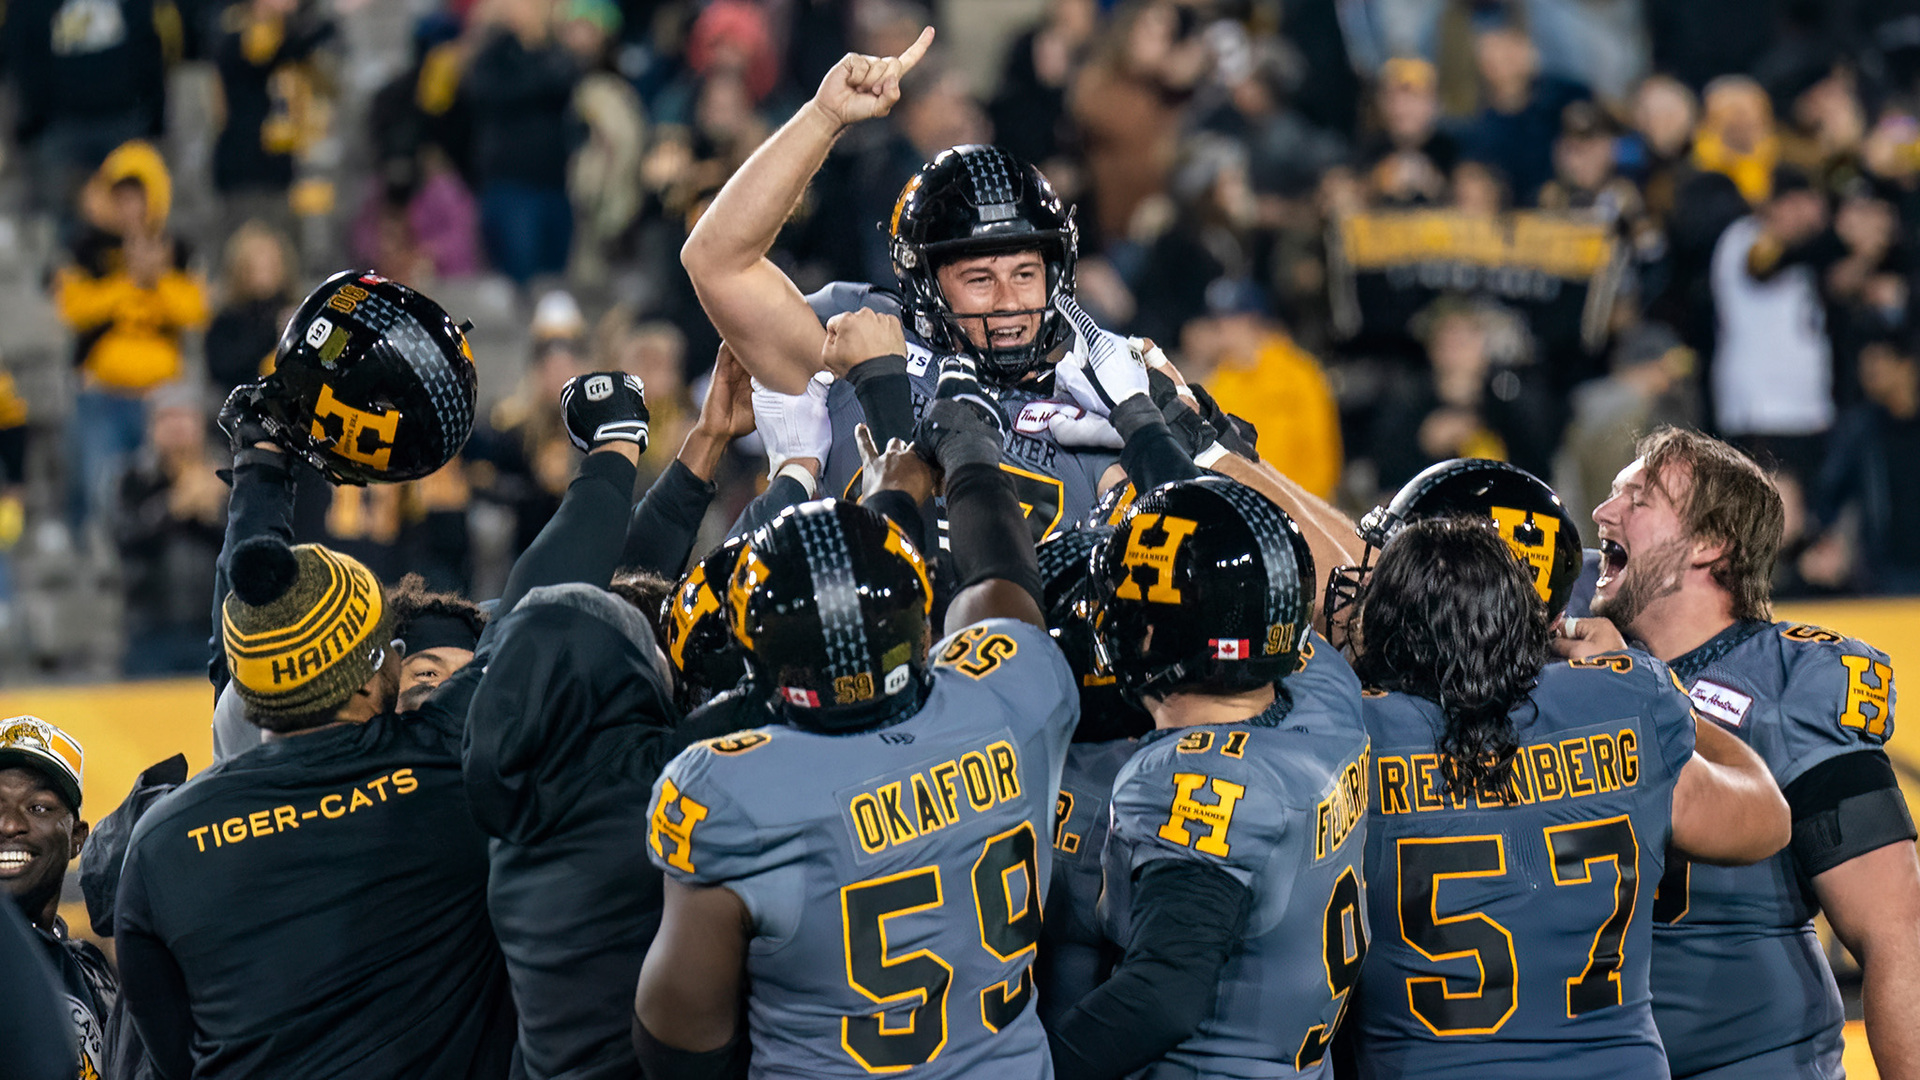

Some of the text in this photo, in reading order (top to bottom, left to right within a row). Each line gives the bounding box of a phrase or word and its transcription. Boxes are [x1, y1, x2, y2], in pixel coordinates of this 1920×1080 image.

[309, 322, 326, 341] CFL
[311, 383, 399, 471] H
[589, 382, 609, 395] CFL
[1020, 409, 1039, 423] Tim
[1116, 513, 1198, 604] H
[1140, 553, 1170, 562] HAMMER
[271, 569, 370, 684] HAMILTO
[1265, 622, 1295, 656] 91
[834, 671, 876, 704] 59
[1840, 654, 1893, 736] H
[1176, 731, 1250, 760] 91
[187, 768, 419, 853] TIGER-CATS
[649, 776, 709, 874] H
[850, 740, 1021, 854] OKAFOR
[1158, 772, 1246, 858] H
[1177, 804, 1226, 821] THE HAMMER
[840, 820, 1044, 1074] 59
[1397, 813, 1640, 1037] 57
